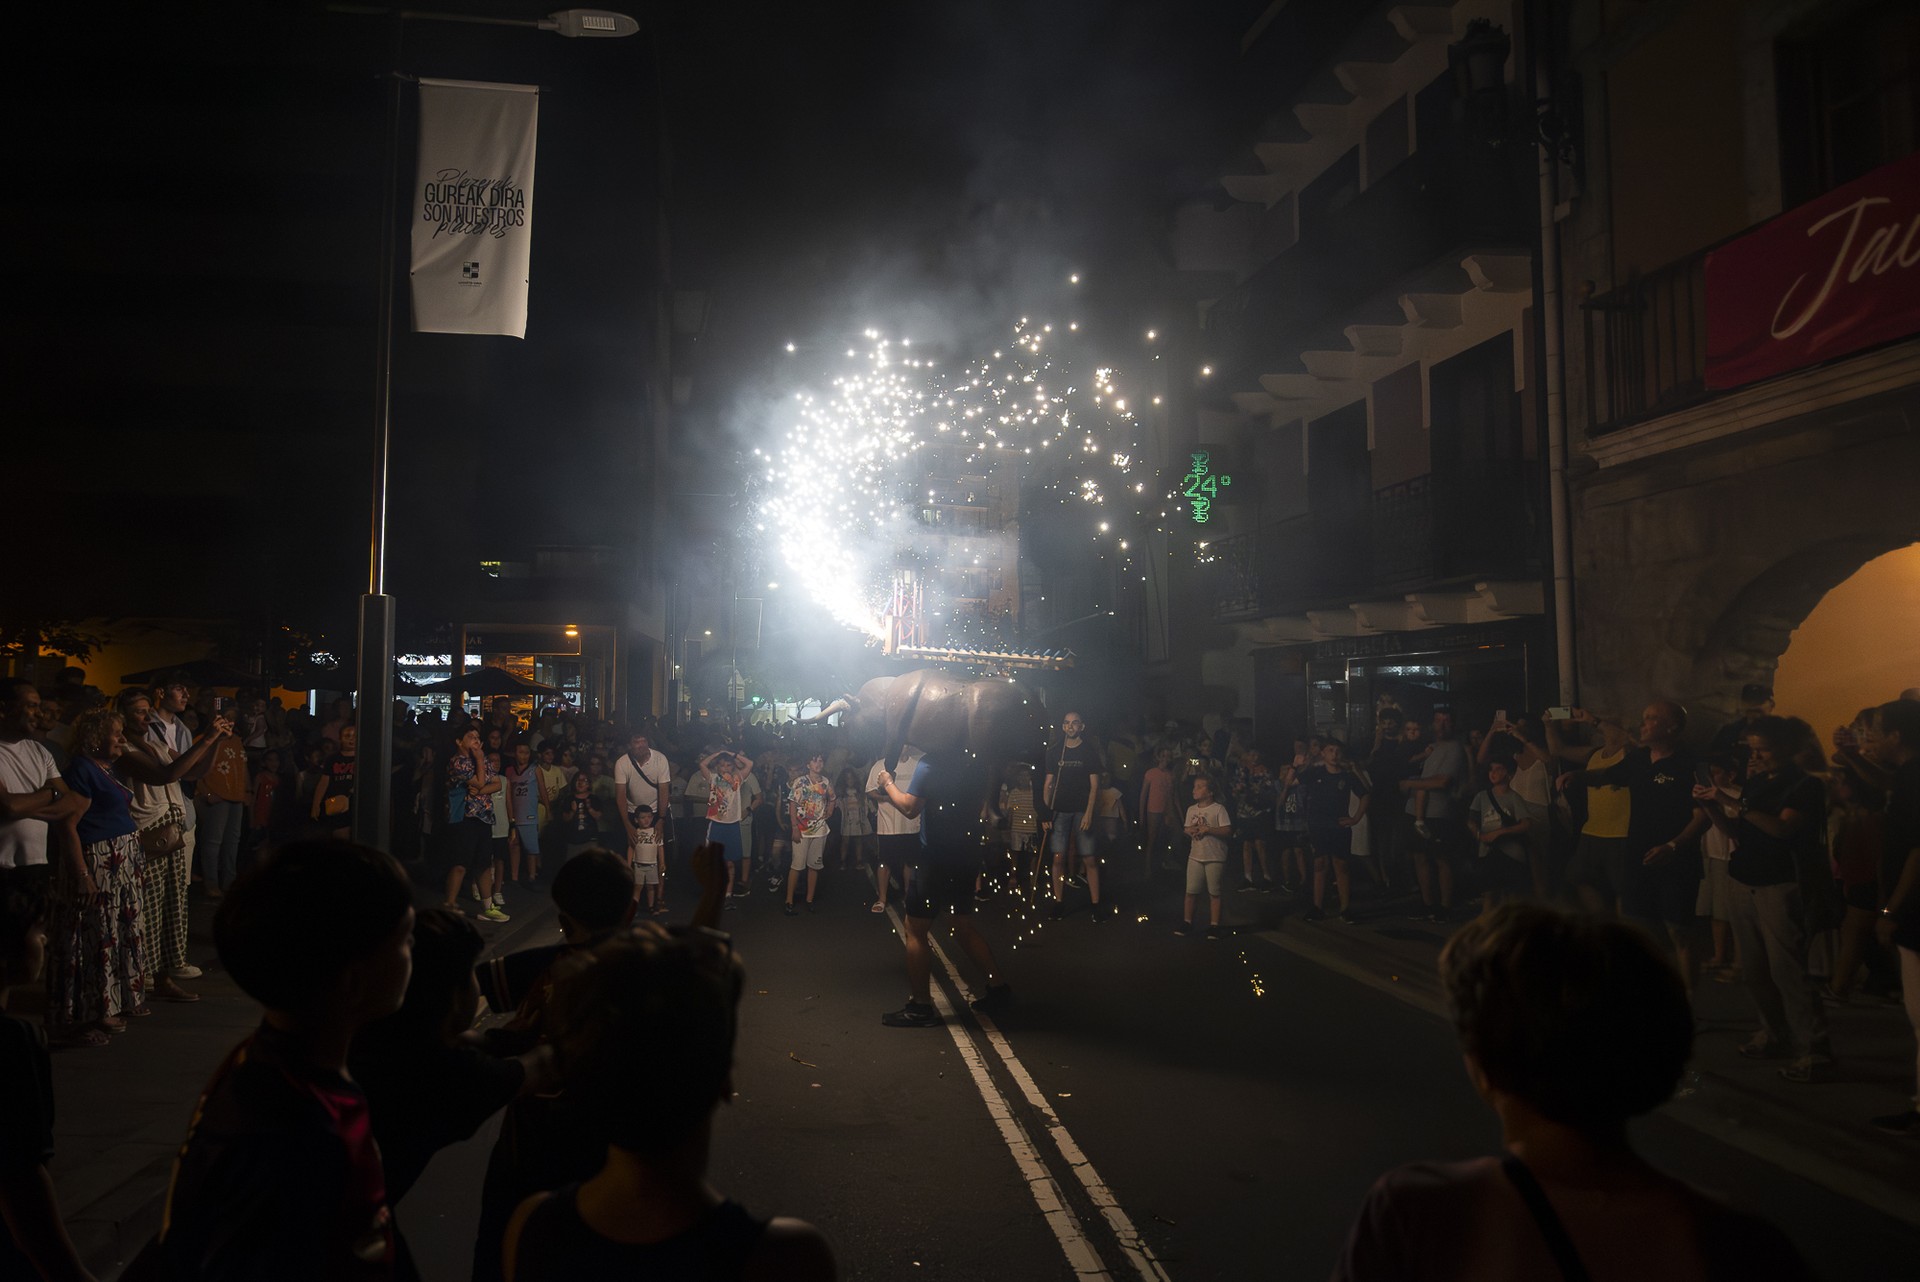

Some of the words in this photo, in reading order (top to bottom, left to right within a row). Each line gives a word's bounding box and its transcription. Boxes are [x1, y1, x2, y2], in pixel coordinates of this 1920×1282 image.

[424, 183, 486, 206] GUREAK
[490, 187, 525, 208] DIRA
[423, 203, 452, 222] SON
[455, 205, 524, 227] NUESTROS
[432, 217, 511, 239] placeres
